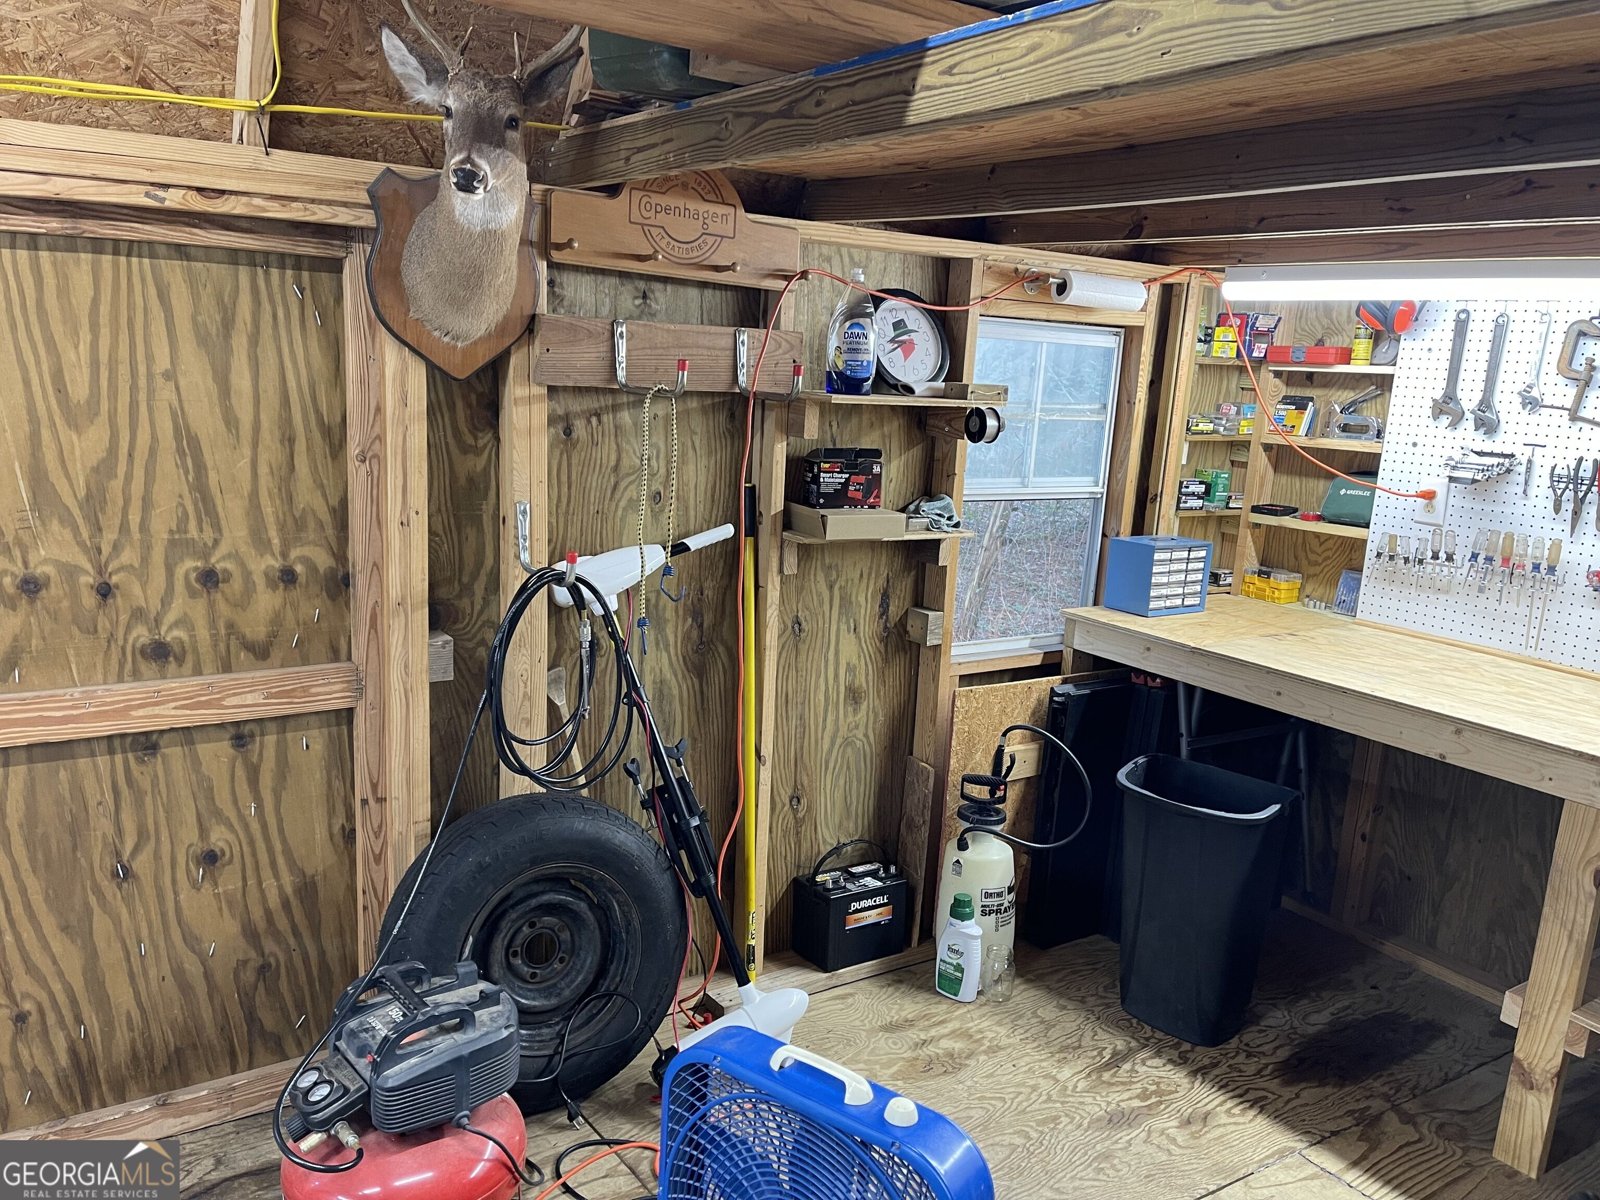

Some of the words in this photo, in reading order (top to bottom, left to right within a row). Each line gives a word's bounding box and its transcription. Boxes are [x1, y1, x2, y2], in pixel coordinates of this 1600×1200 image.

[656, 175, 681, 190] SINCE
[694, 178, 711, 196] 1822
[638, 194, 729, 231] Copenhagen
[655, 232, 666, 242] IT
[665, 239, 709, 255] SATISFIES
[844, 331, 868, 340] DAWN
[923, 331, 931, 342] 3
[924, 347, 931, 357] 4
[888, 357, 896, 369] 8
[1346, 489, 1371, 497] GREENLEE
[984, 891, 1004, 900] ORTHO
[849, 894, 889, 912] DURACELL
[980, 902, 1016, 917] SPRAYE
